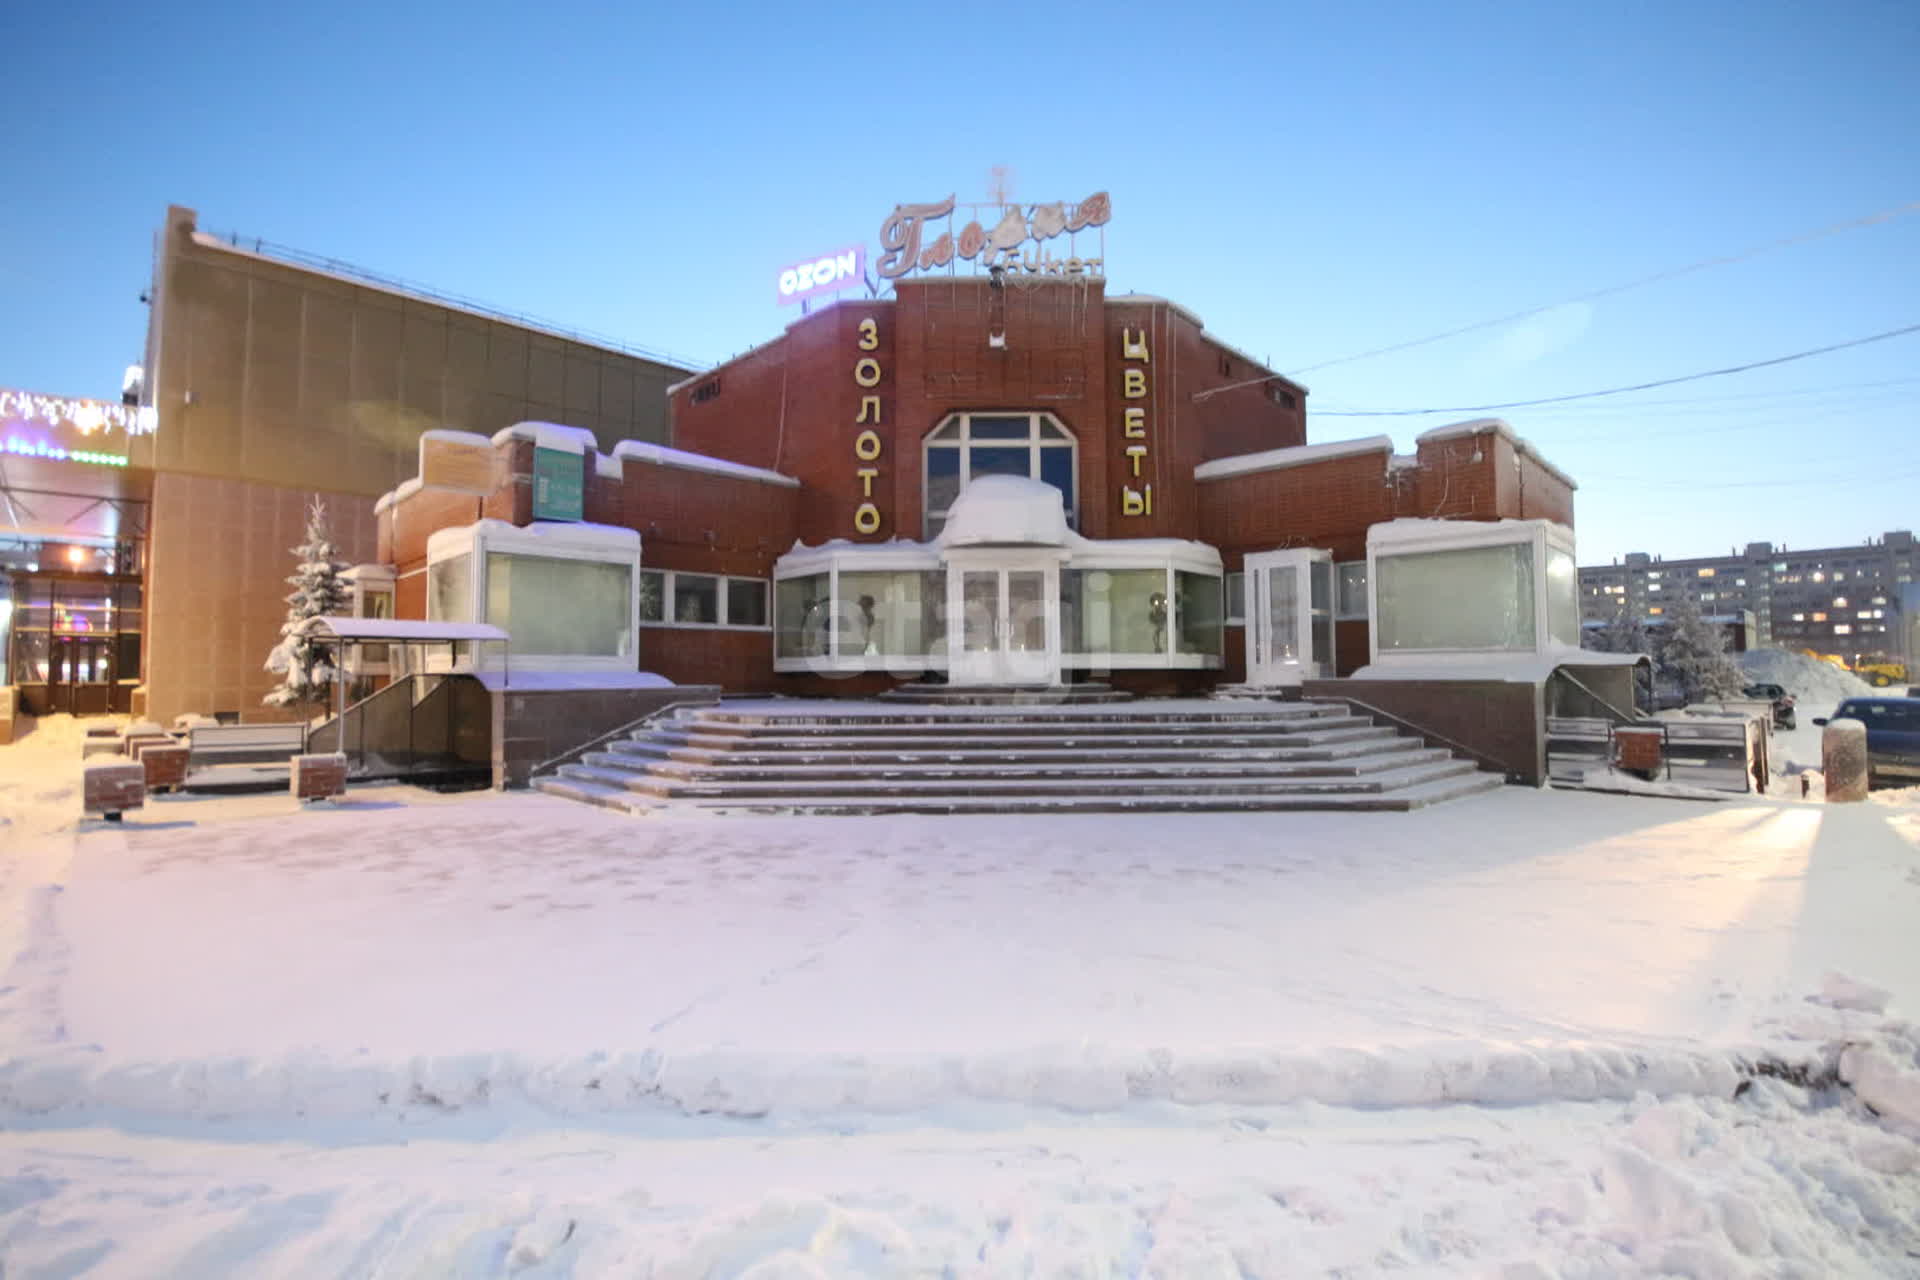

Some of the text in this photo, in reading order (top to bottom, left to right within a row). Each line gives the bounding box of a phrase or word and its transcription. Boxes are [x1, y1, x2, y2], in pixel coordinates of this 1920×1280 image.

[778, 251, 857, 296] OZON
[854, 318, 882, 535] ЗОЛОТО
[1121, 327, 1153, 517] ЦВЕТЫ
